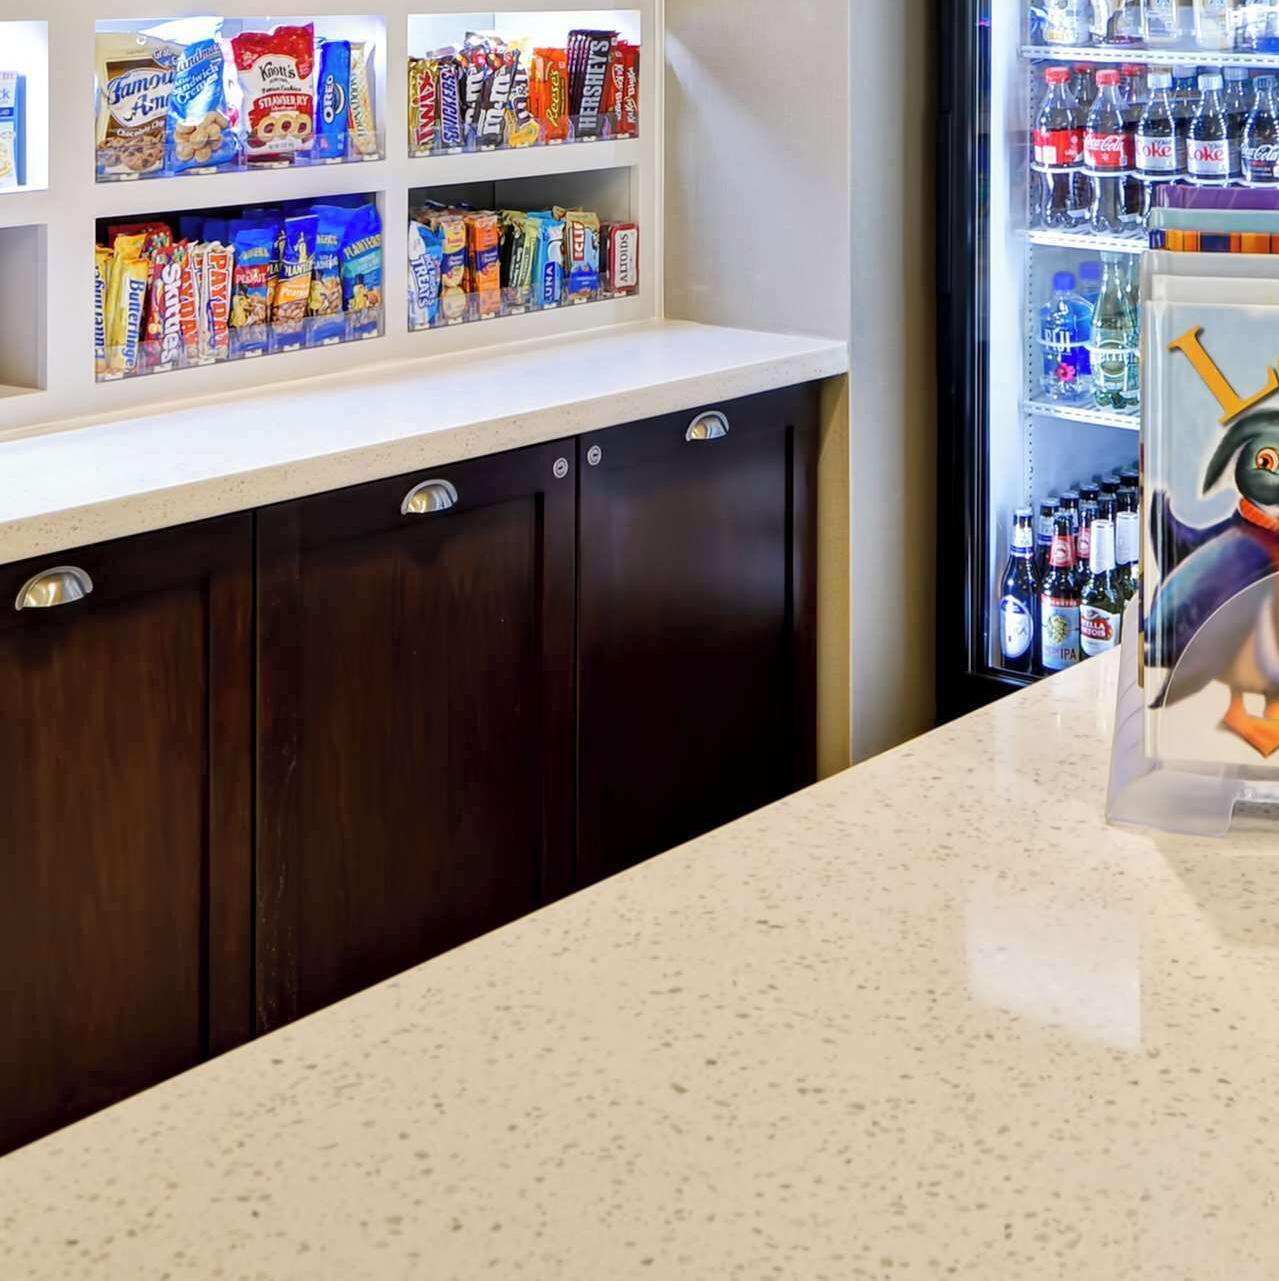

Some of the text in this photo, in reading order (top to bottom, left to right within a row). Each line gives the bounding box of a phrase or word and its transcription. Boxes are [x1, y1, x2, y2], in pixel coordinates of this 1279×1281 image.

[259, 61, 296, 81] Knott's
[579, 40, 609, 129] HERSHEY'S
[258, 95, 308, 110] STRAWBERRY
[323, 74, 335, 124] OREO
[419, 72, 435, 144] TWIX
[441, 69, 460, 143] SNICKERS
[1241, 144, 1279, 162] Coca-Cola
[410, 256, 431, 308] TREATS
[621, 233, 629, 282] ALTOIDS
[160, 262, 183, 364] Skittles
[208, 252, 229, 349] PAYDAY
[1045, 328, 1071, 353] FIJI
[1060, 648, 1076, 661] IPA
